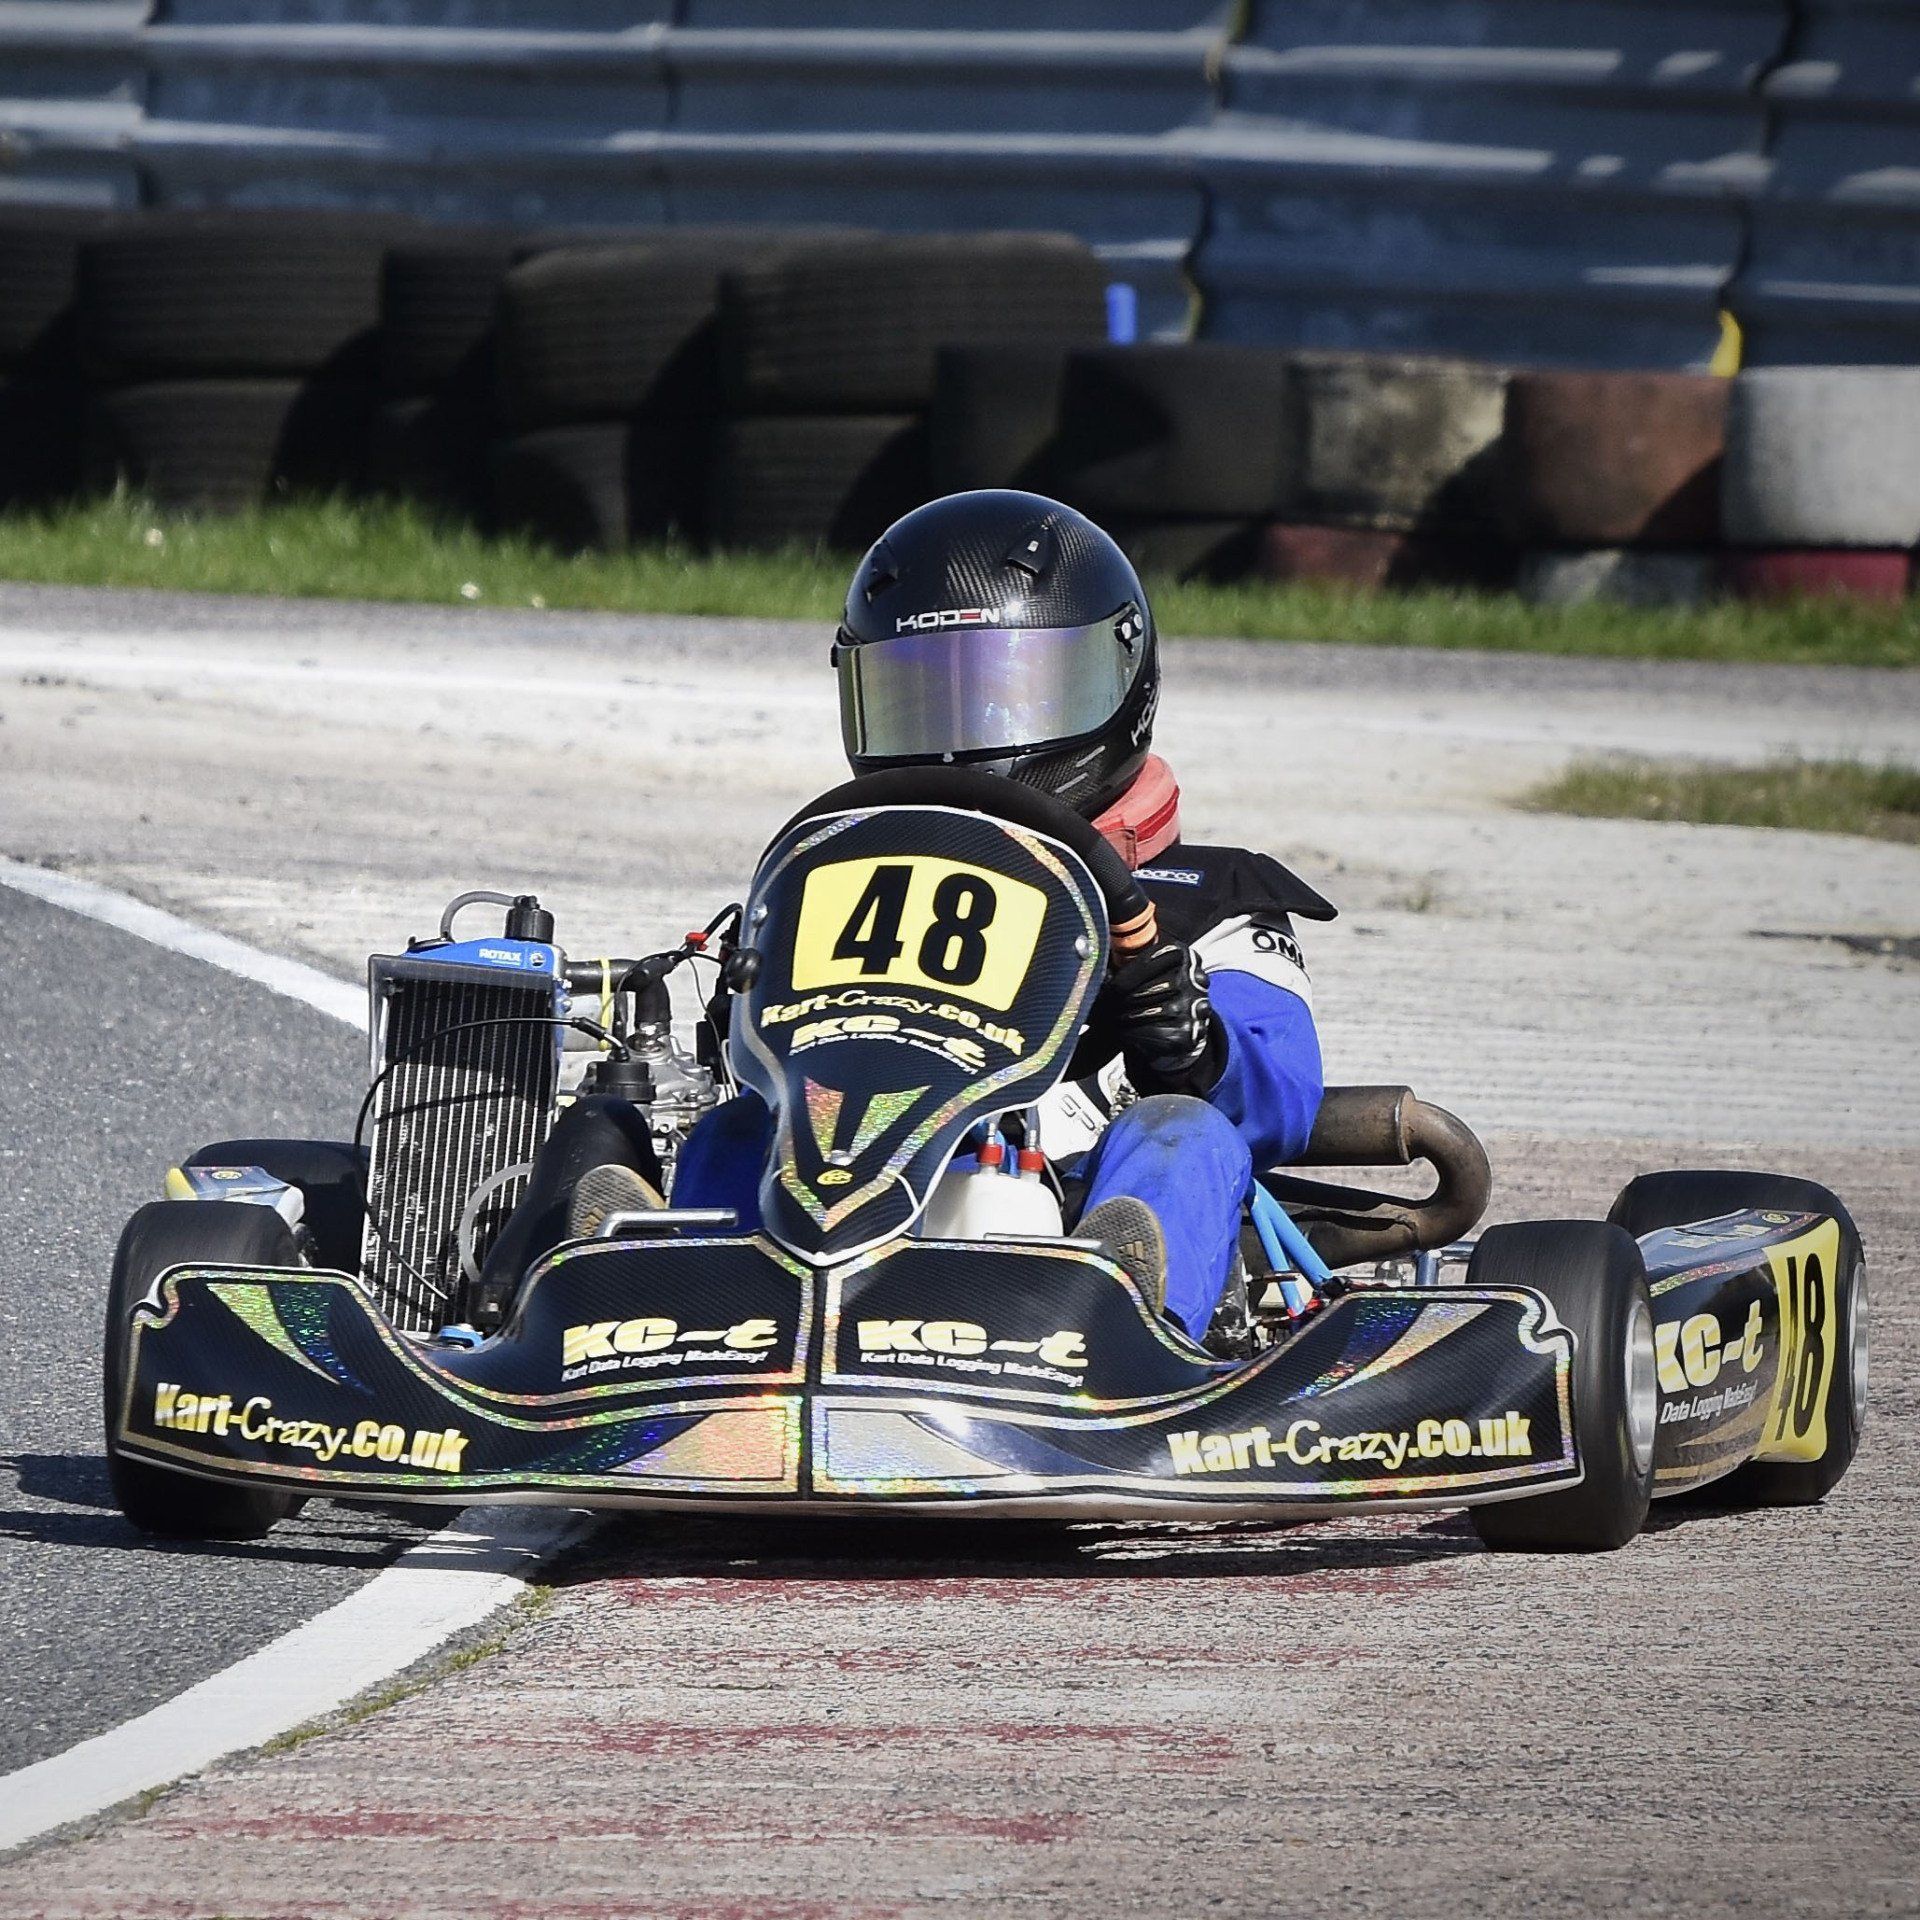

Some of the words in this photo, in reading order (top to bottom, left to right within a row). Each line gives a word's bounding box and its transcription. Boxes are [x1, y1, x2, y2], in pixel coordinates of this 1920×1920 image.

[896, 608, 1000, 632] KODEN
[831, 865, 997, 987] 48
[479, 948, 522, 962] ROTAX
[761, 990, 1026, 1056] Kart-Crazy.co.uk
[622, 1352, 683, 1368] Logging
[937, 1354, 1002, 1374] Logging
[1660, 1401, 1691, 1424] Data
[154, 1382, 469, 1472] Kart-Crazy.co.uk
[1166, 1411, 1532, 1474] Kart-Crazy.co.uk
